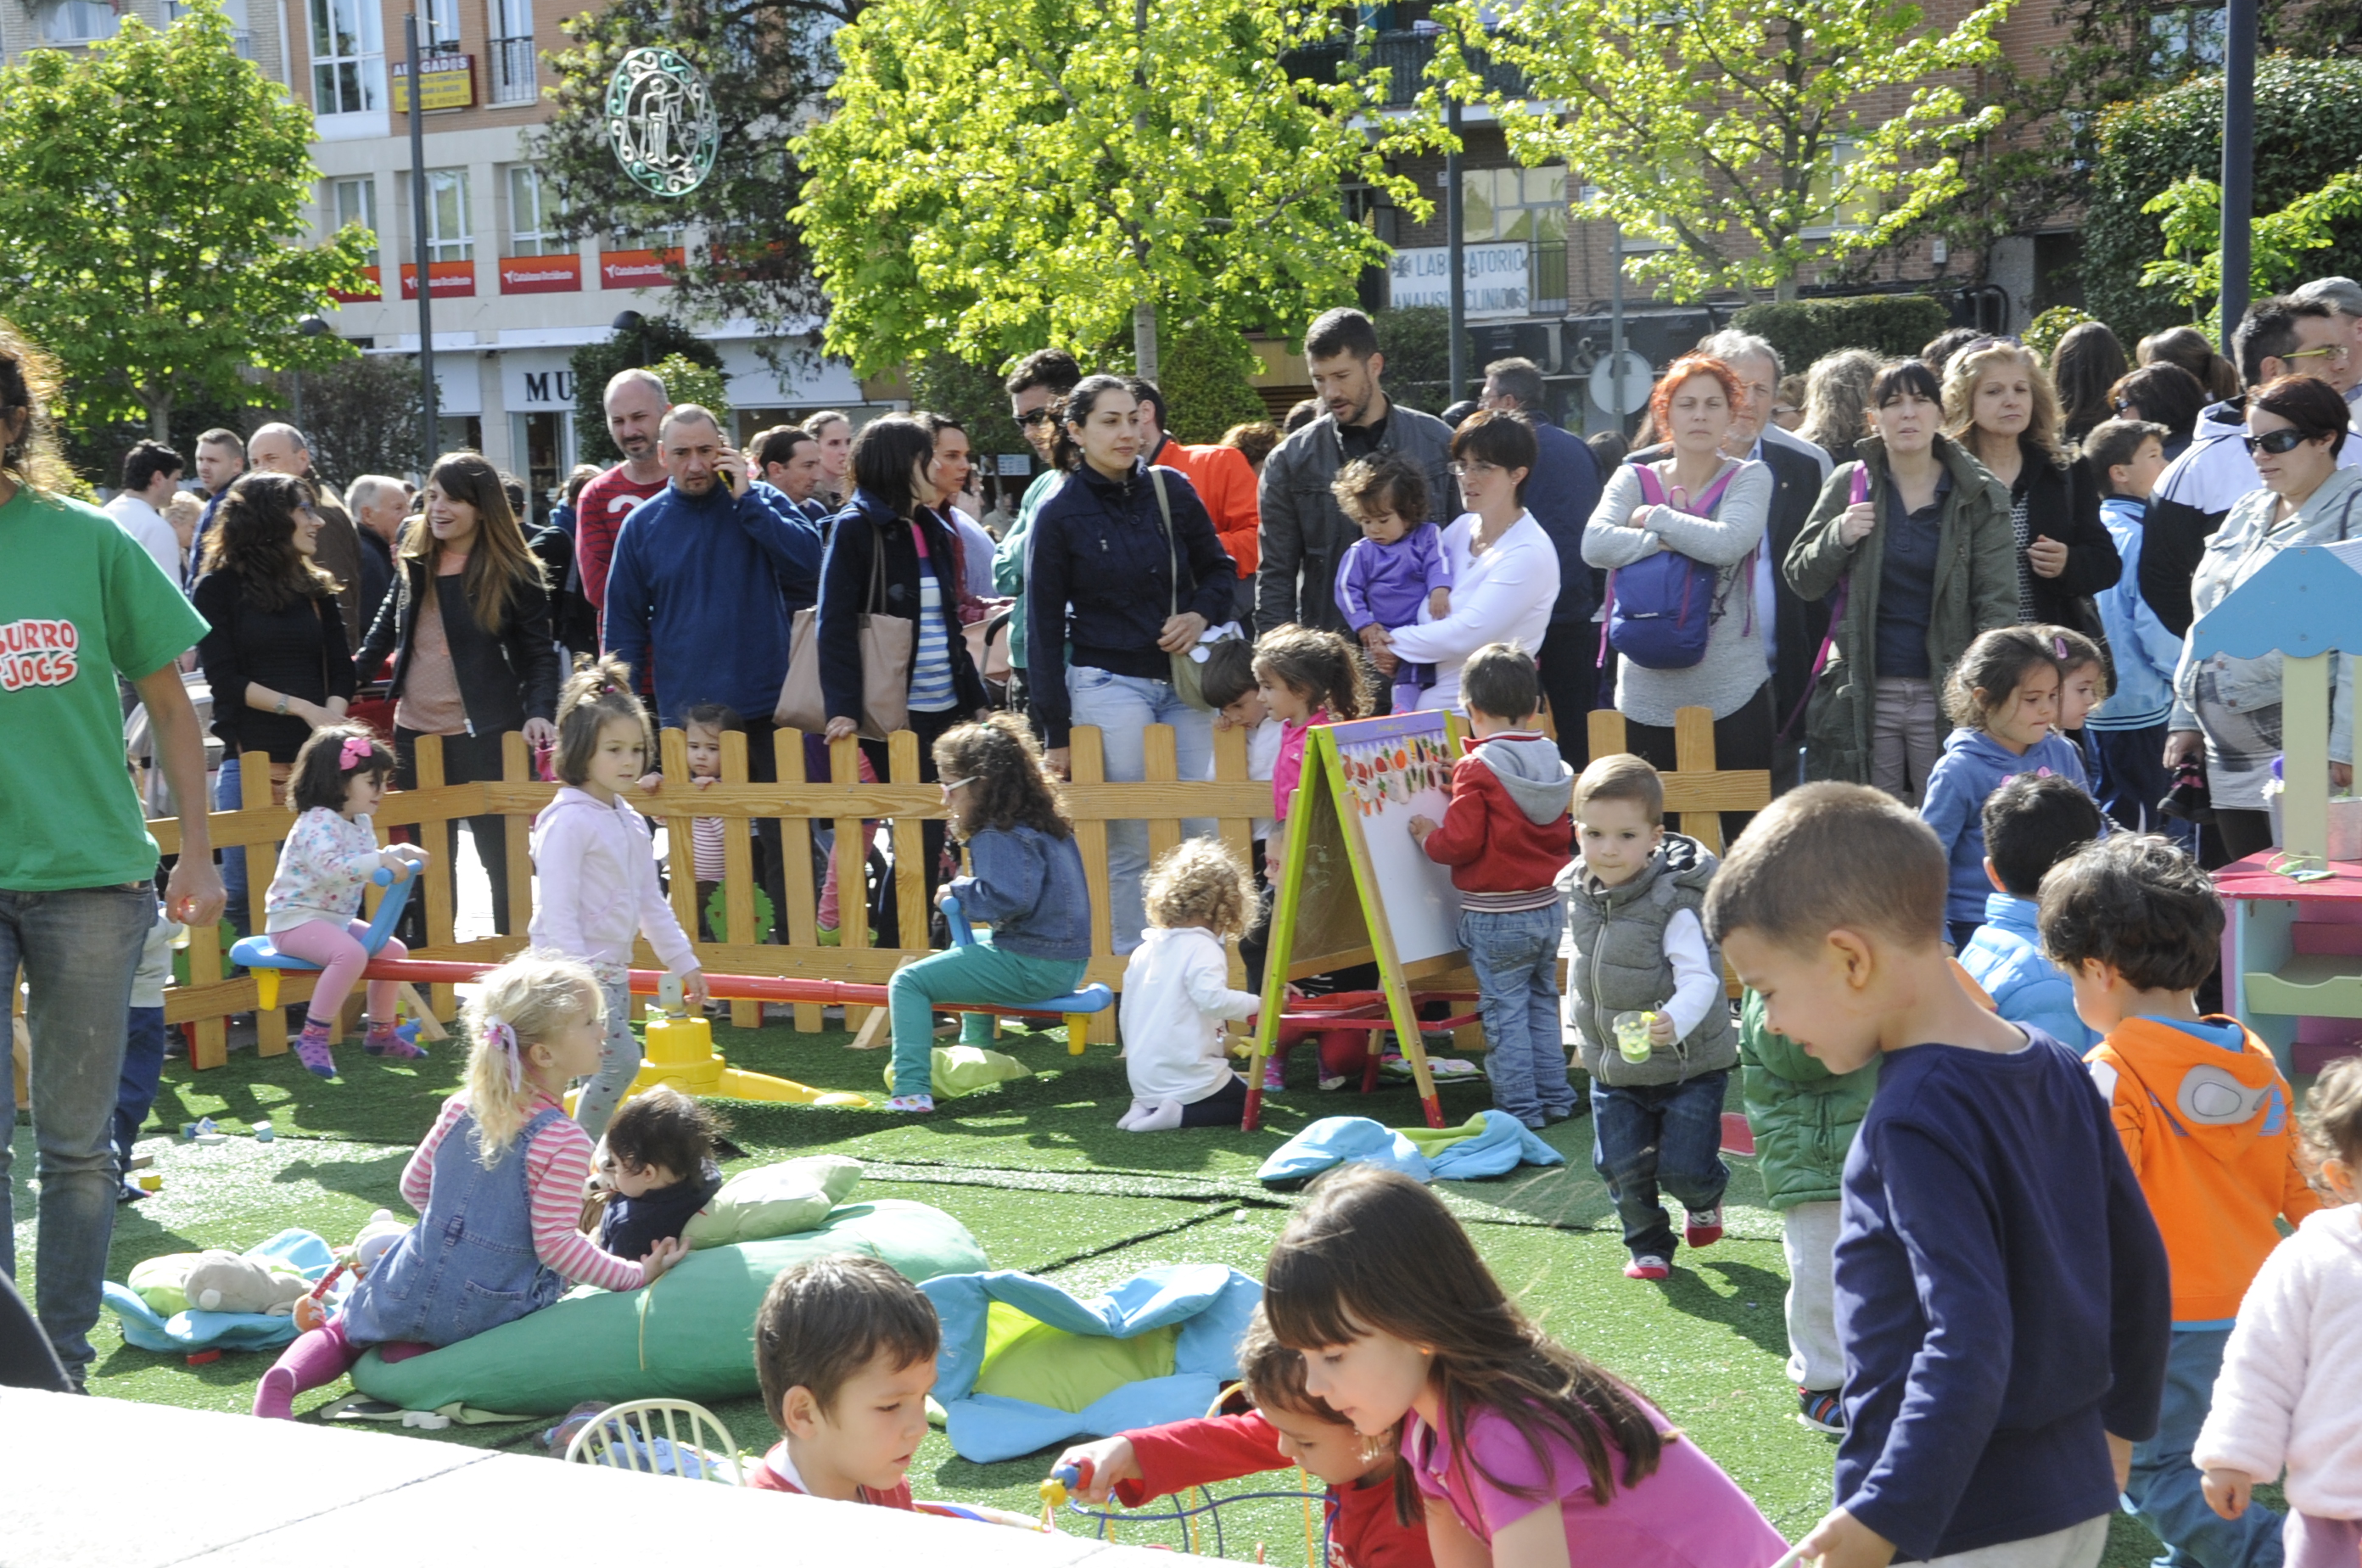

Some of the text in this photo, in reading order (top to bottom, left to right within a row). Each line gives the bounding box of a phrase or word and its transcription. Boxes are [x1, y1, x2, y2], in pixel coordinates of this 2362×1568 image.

[393, 57, 468, 76] AGADOS
[1417, 249, 1524, 277] LABATORIO
[0, 622, 75, 654] URRO
